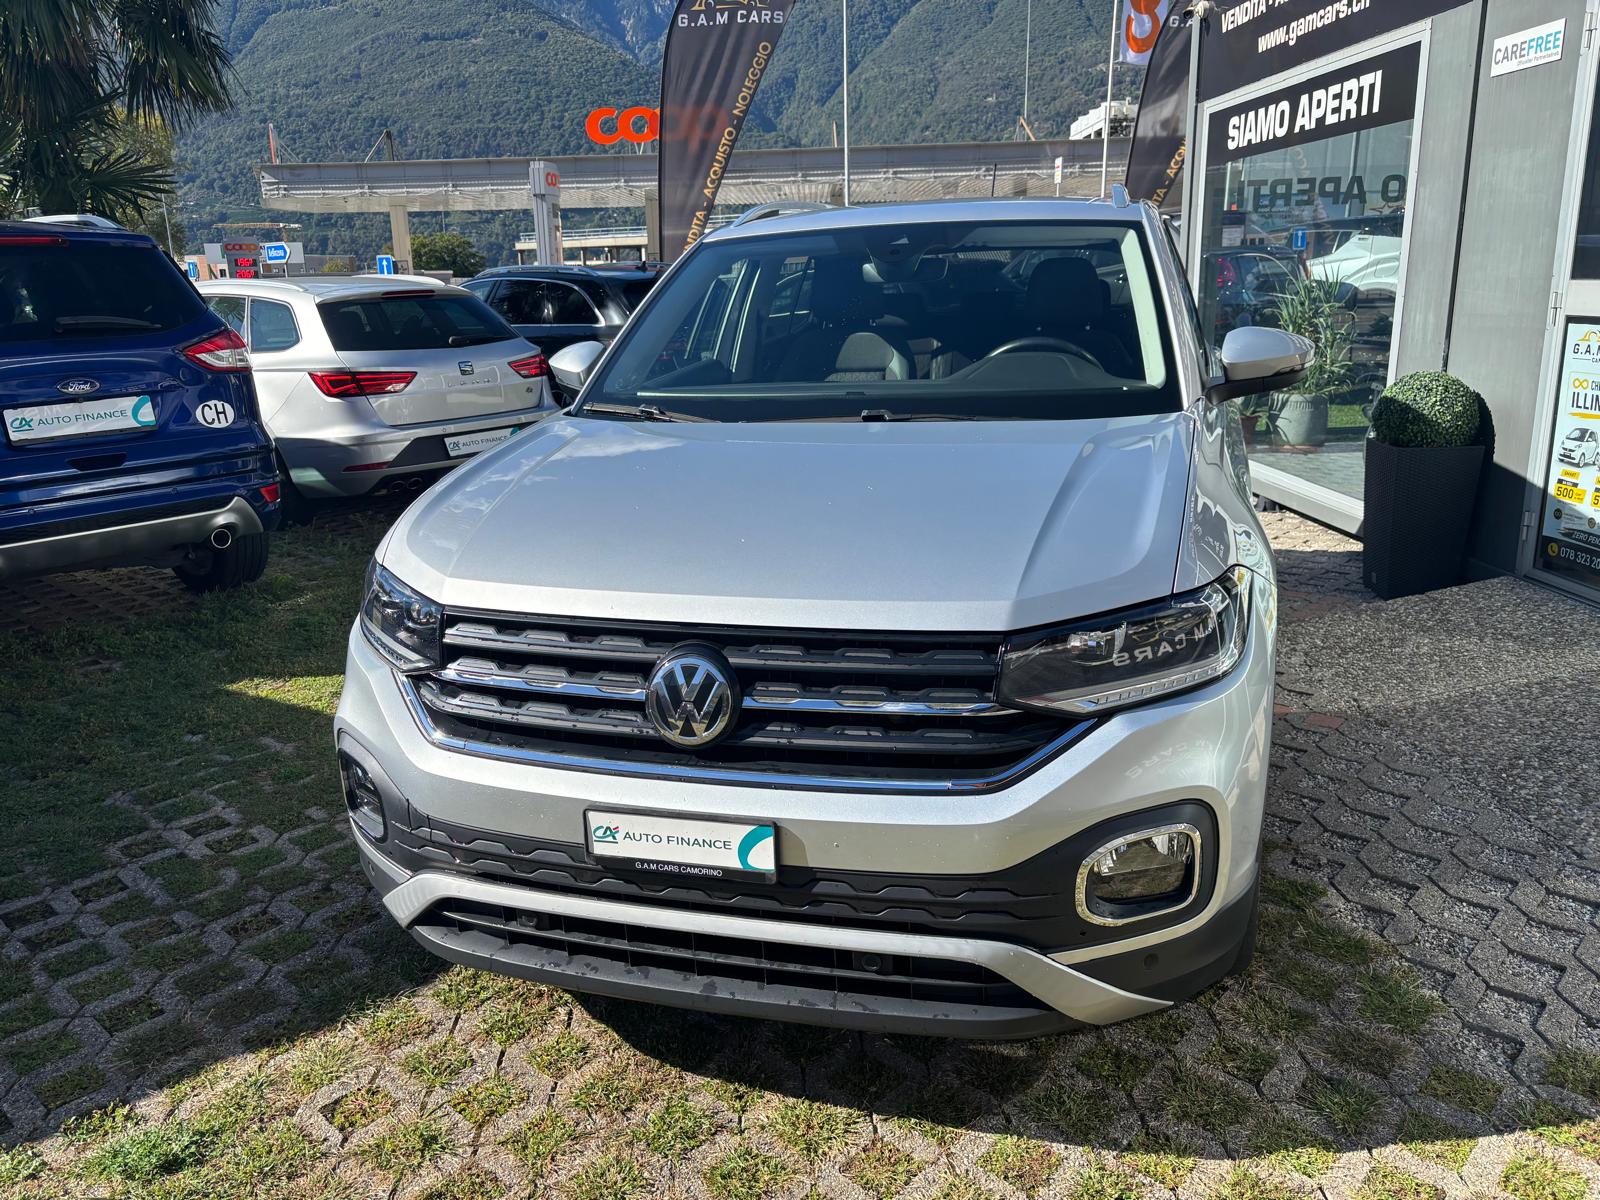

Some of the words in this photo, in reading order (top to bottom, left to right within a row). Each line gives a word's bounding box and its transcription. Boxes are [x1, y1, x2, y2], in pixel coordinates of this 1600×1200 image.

[677, 11, 729, 27] G.A.M
[737, 10, 784, 24] CARS
[1221, 0, 1267, 33] VENDITA
[1258, 0, 1370, 53] www.gamcars.ch
[1493, 30, 1562, 65] CAREFREE
[1227, 100, 1290, 150] SIAMO
[1295, 70, 1383, 132] APERTI
[683, 211, 705, 252] NDITA
[703, 127, 736, 198] ACQUISTO
[733, 41, 772, 117] NOLEGGIO
[1572, 343, 1600, 356] G.A.
[68, 381, 91, 391] Ford
[37, 415, 72, 427] AUTO
[75, 409, 129, 422] FINANCE
[201, 403, 229, 426] CH
[462, 438, 480, 447] AUTO
[480, 435, 508, 444] FINANCE
[1556, 486, 1574, 499] 500
[1560, 546, 1575, 560] 078
[1576, 551, 1591, 566] 323
[623, 831, 663, 844] AUTO
[666, 835, 733, 850] FINANCE
[635, 861, 657, 871] G.A.M
[658, 863, 680, 873] CARS
[680, 867, 723, 877] CAMORINO
